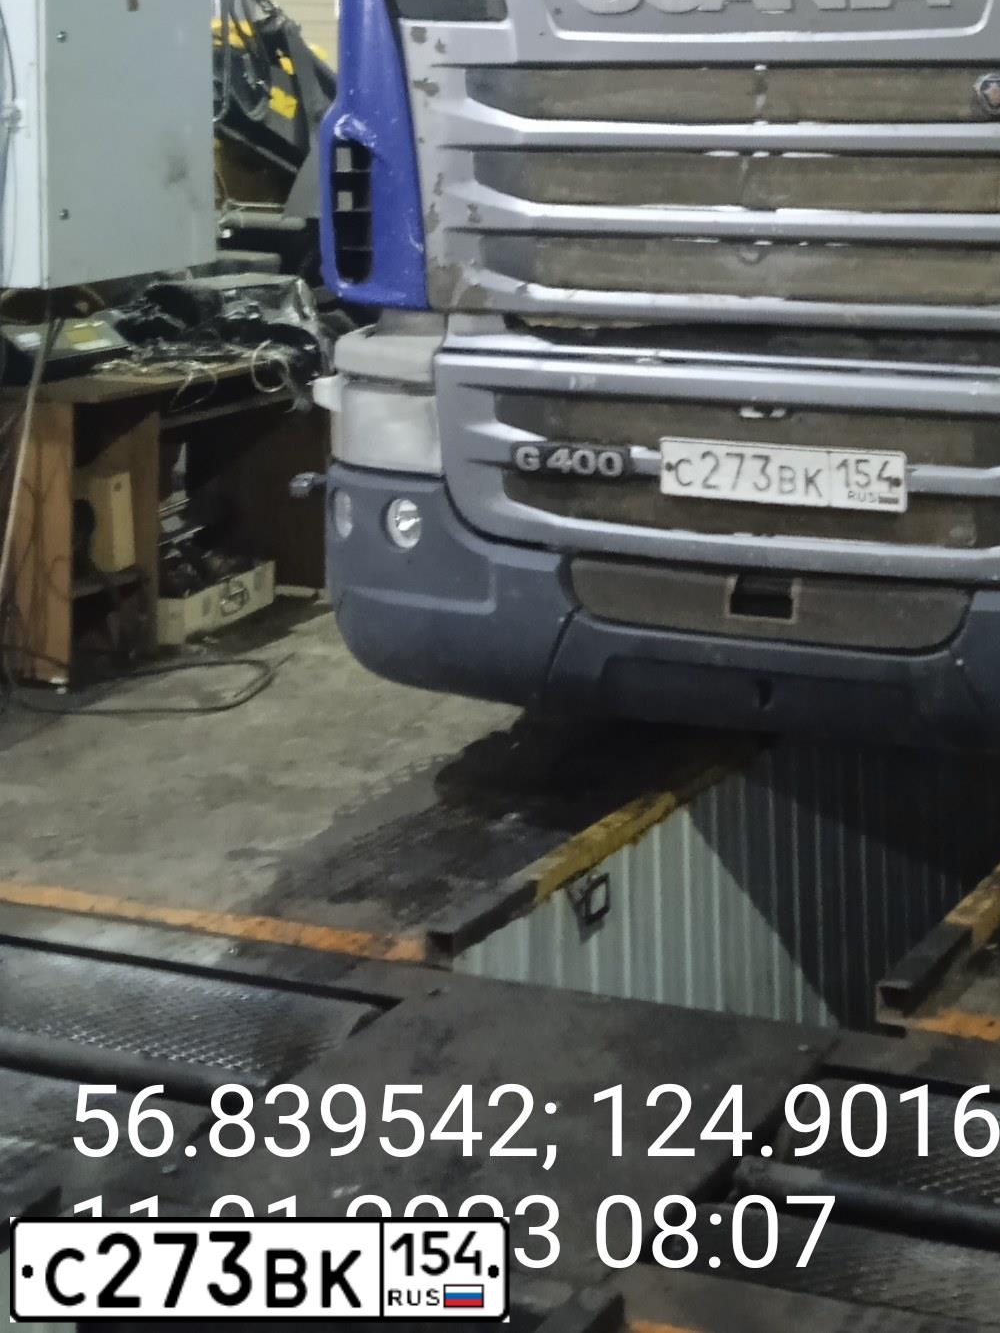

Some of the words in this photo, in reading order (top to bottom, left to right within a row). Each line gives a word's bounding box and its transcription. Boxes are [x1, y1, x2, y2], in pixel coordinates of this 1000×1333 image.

[515, 445, 541, 471] G
[550, 446, 623, 478] 400
[836, 458, 894, 490] 154
